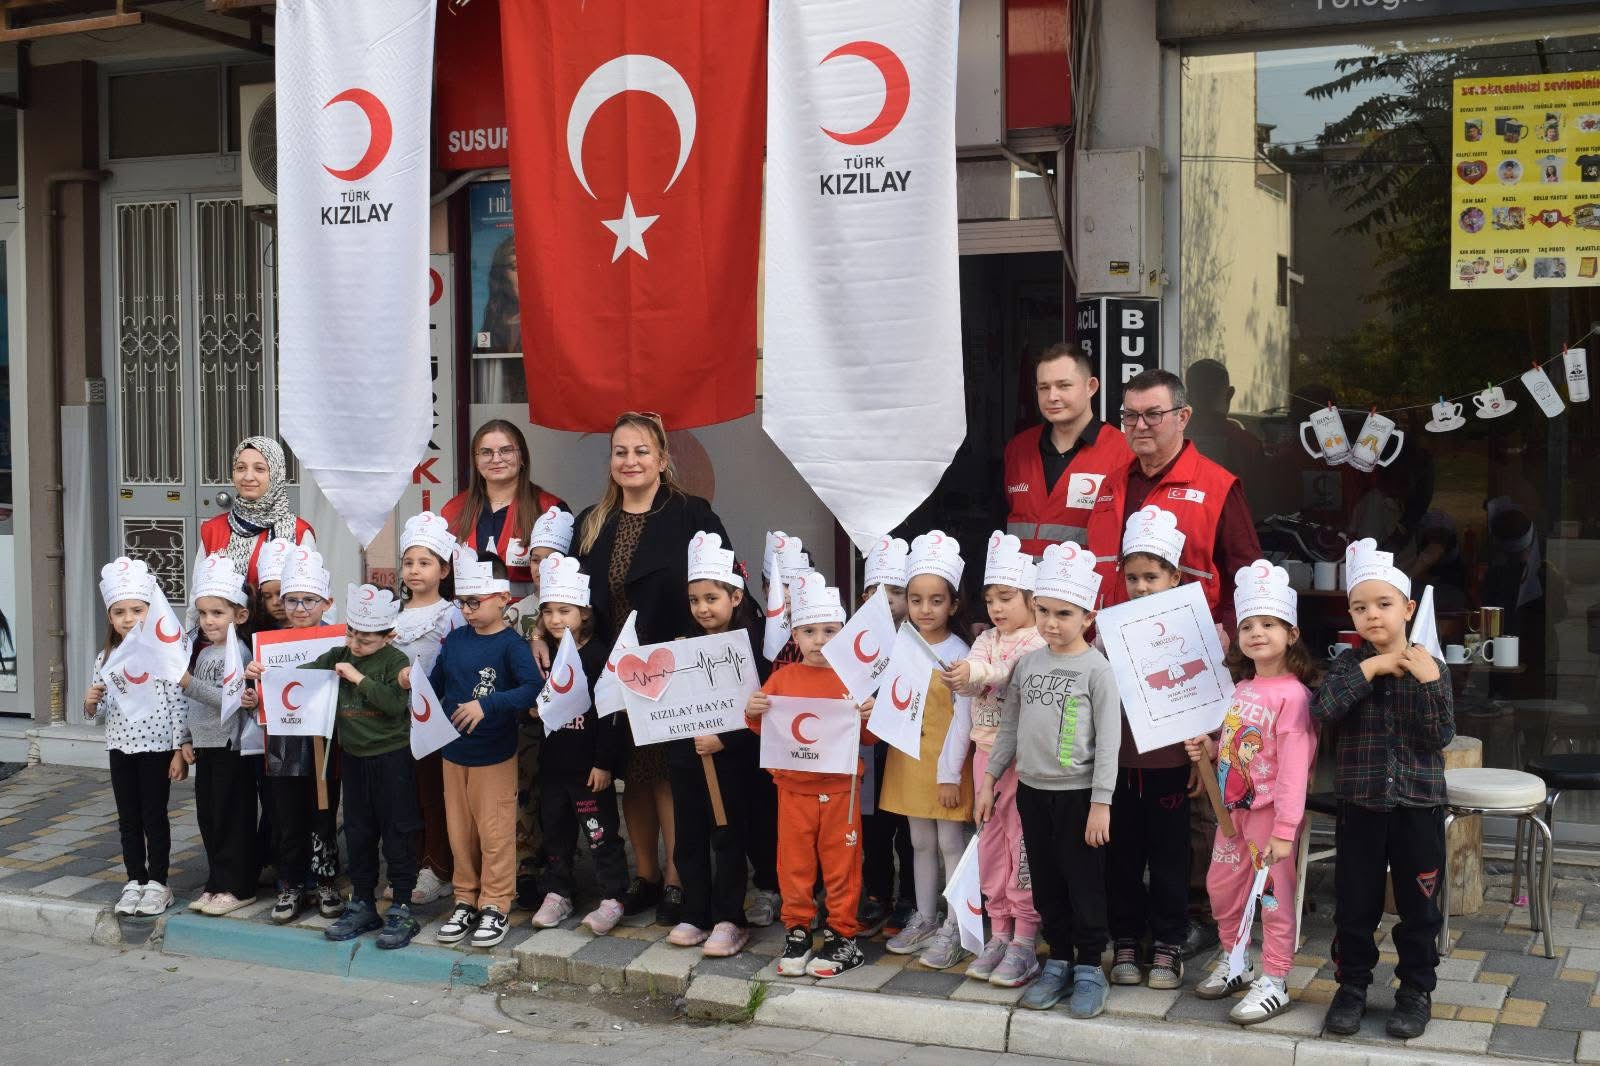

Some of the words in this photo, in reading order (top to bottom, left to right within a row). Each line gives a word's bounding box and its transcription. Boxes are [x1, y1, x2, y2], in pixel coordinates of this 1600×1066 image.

[844, 154, 886, 170] TÜRK
[820, 170, 912, 196] KIZILAY
[341, 189, 371, 203] TÜRK
[321, 203, 394, 226] KIZILAY
[372, 571, 397, 586] 503
[1022, 673, 1076, 694] ACTIVE
[650, 704, 693, 721] KIZILAY
[696, 698, 735, 715] HAYAT
[669, 717, 725, 735] KURTARIR
